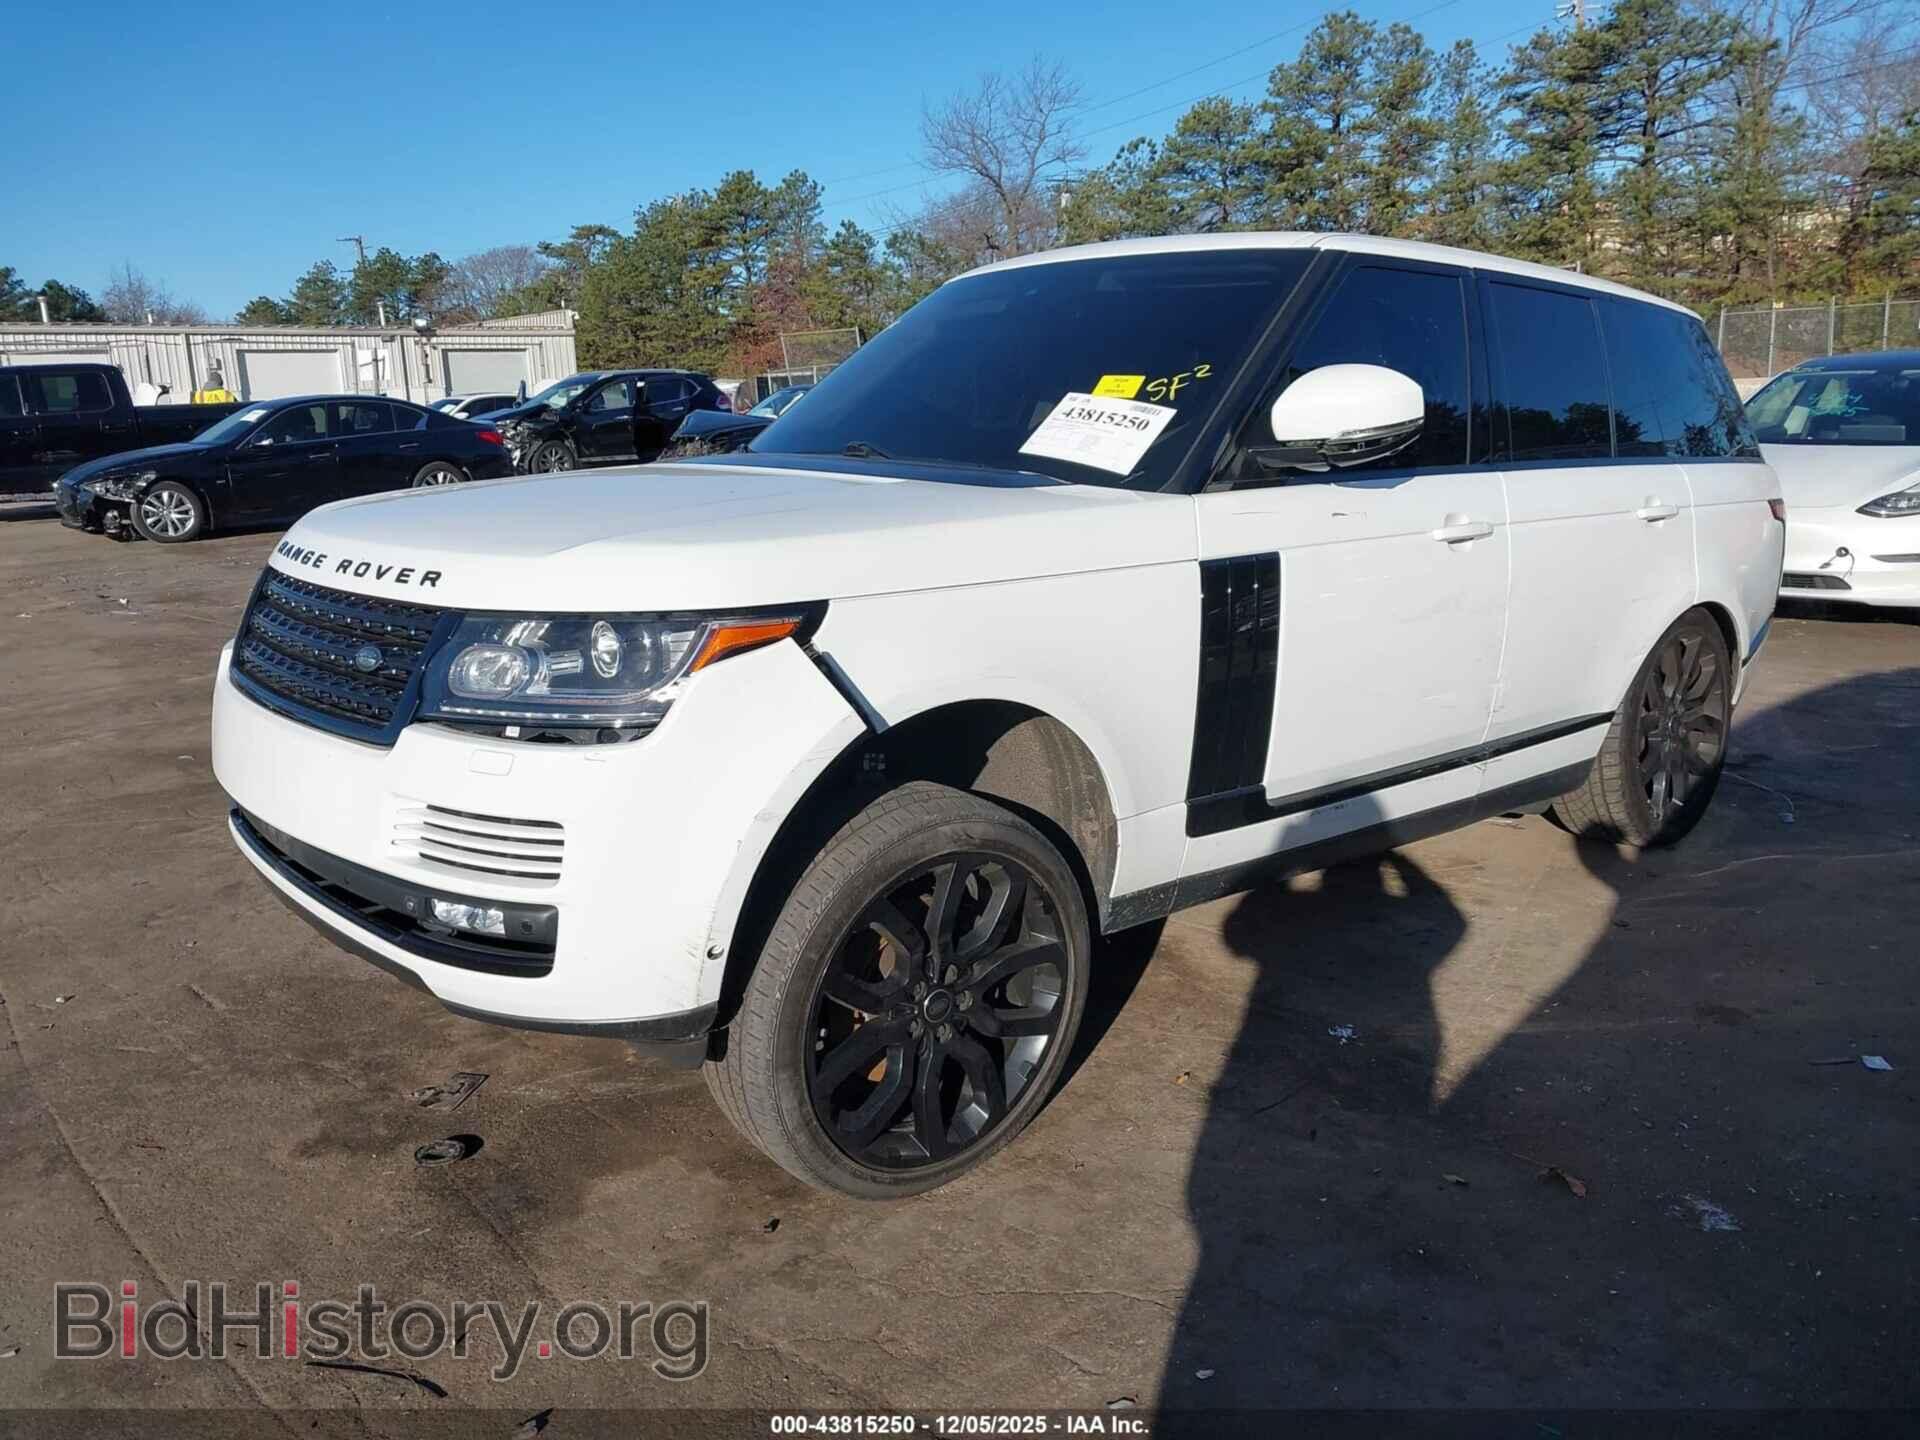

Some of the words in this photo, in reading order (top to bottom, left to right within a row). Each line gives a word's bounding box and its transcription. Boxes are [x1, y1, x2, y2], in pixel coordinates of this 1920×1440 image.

[1062, 406, 1150, 432] 43815250
[278, 541, 327, 568] RANGE
[336, 559, 442, 587] ROVER
